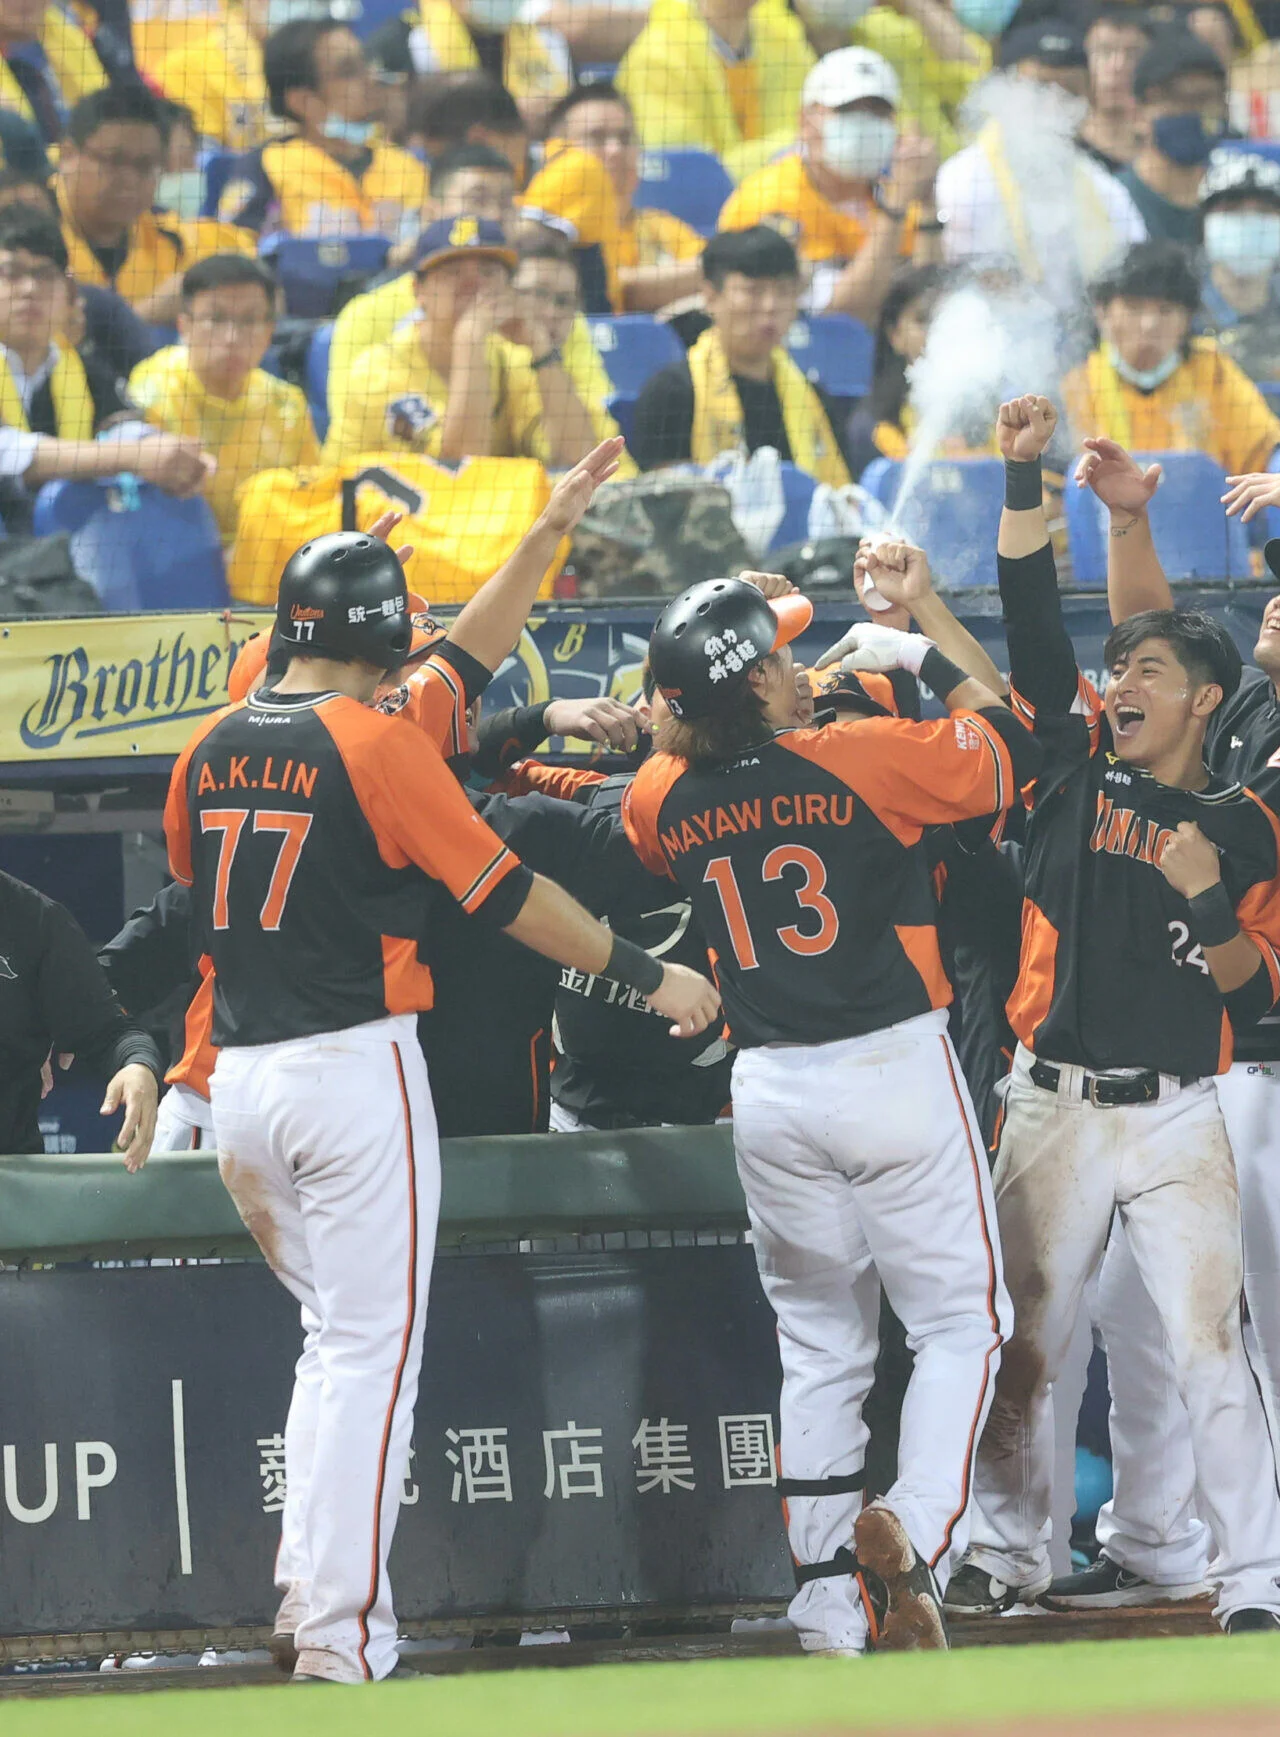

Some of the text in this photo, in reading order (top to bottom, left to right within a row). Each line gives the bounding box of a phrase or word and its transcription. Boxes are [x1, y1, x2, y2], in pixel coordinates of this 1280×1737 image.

[293, 621, 315, 641] 77
[19, 630, 246, 750] Brother
[198, 755, 319, 799] A.K.LIN
[200, 807, 314, 932] 77
[660, 797, 763, 862] MAYAW
[771, 794, 854, 827] CIRU
[702, 842, 841, 971] 13
[3, 1440, 118, 1524] UP
